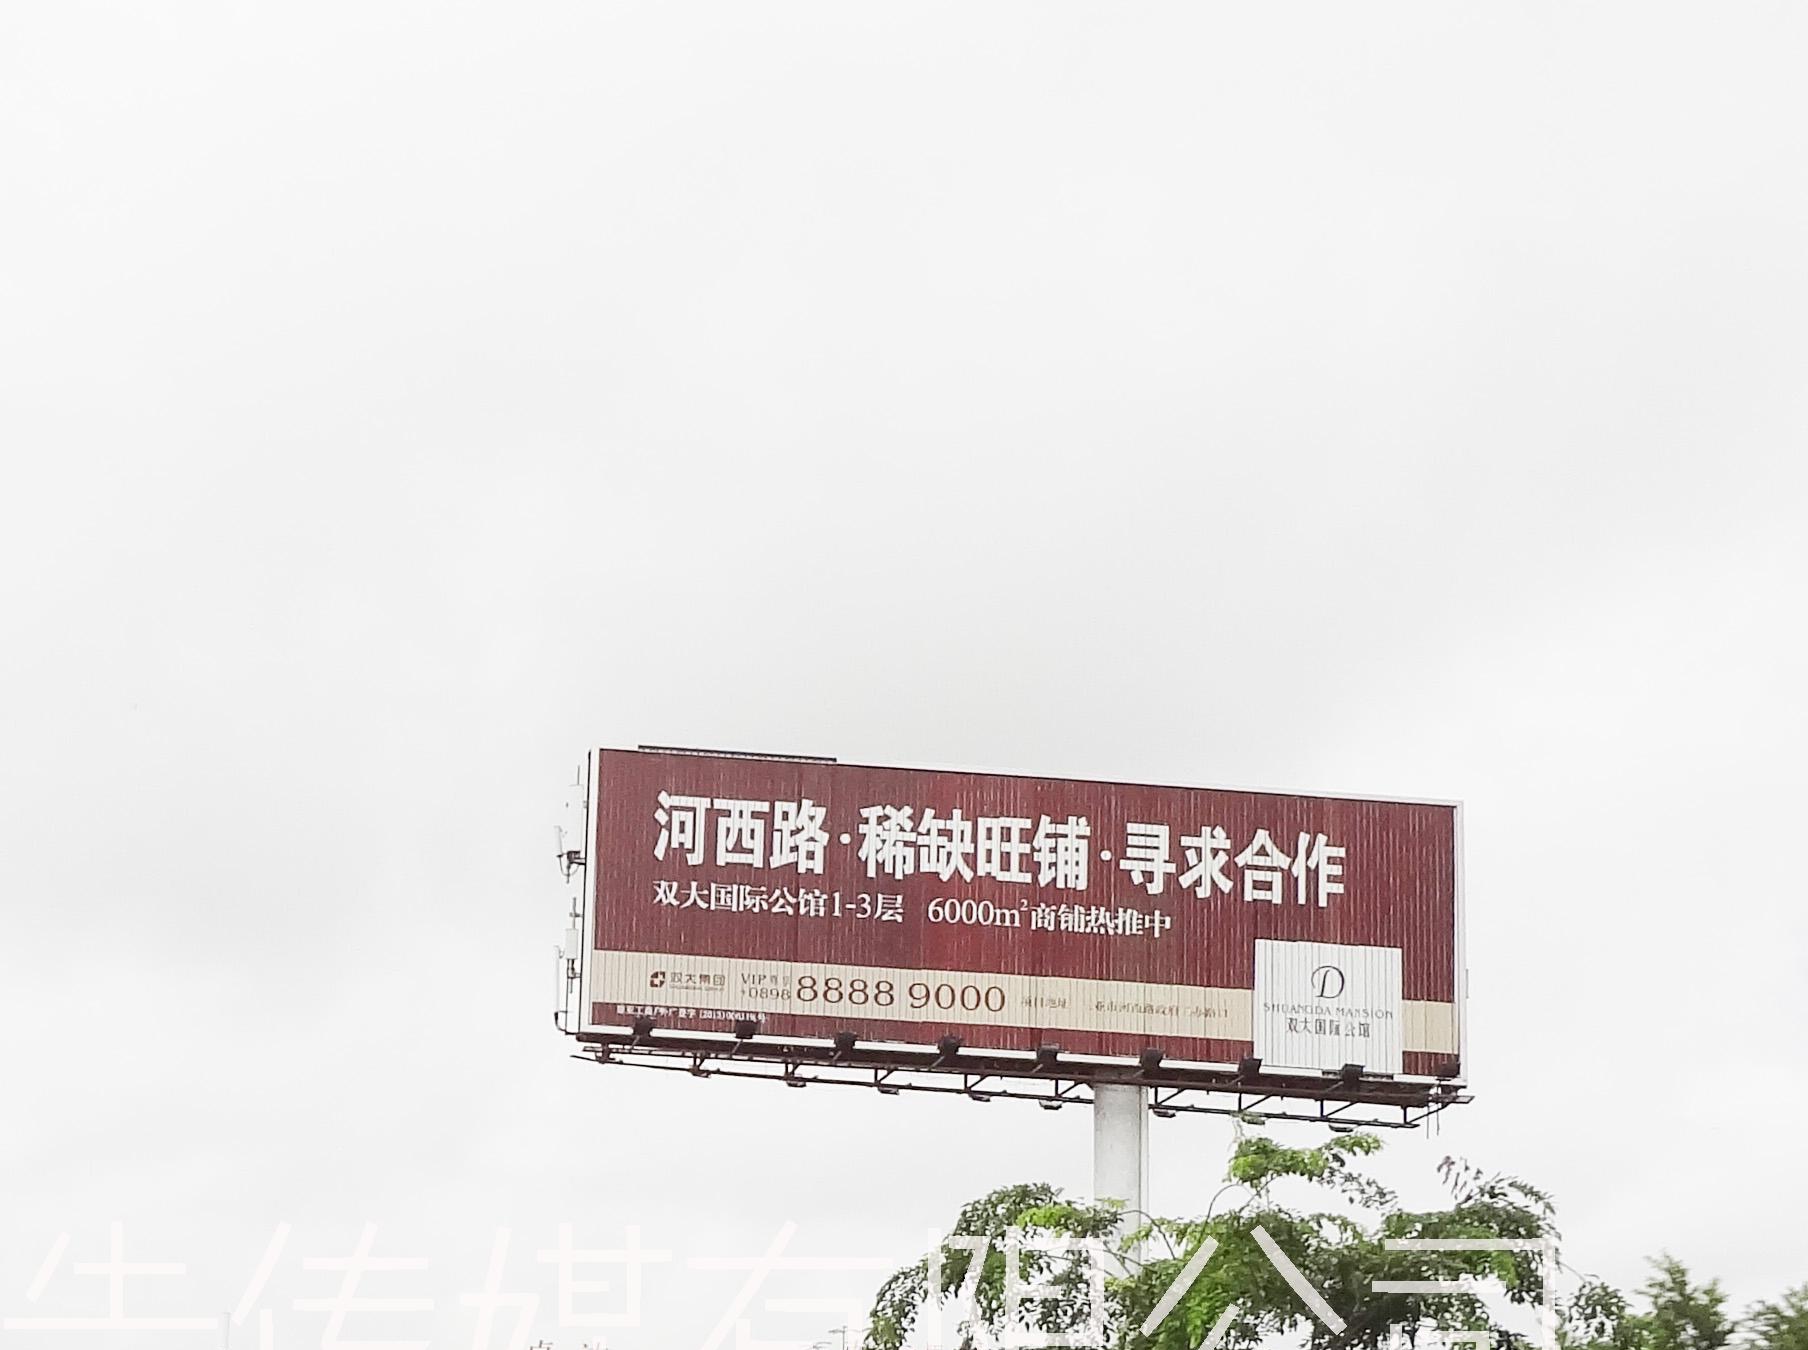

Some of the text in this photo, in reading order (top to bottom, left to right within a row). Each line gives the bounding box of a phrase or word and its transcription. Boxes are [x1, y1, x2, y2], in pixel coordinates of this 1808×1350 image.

[652, 790, 1347, 908] 河西路·稀缺旺铺·寻求合作
[652, 880, 904, 923] 双大国际公馆1-3层
[797, 975, 895, 1007] 8888
[908, 982, 1006, 1012] 9000
[1287, 1016, 1371, 1038] 双大国际公馆
